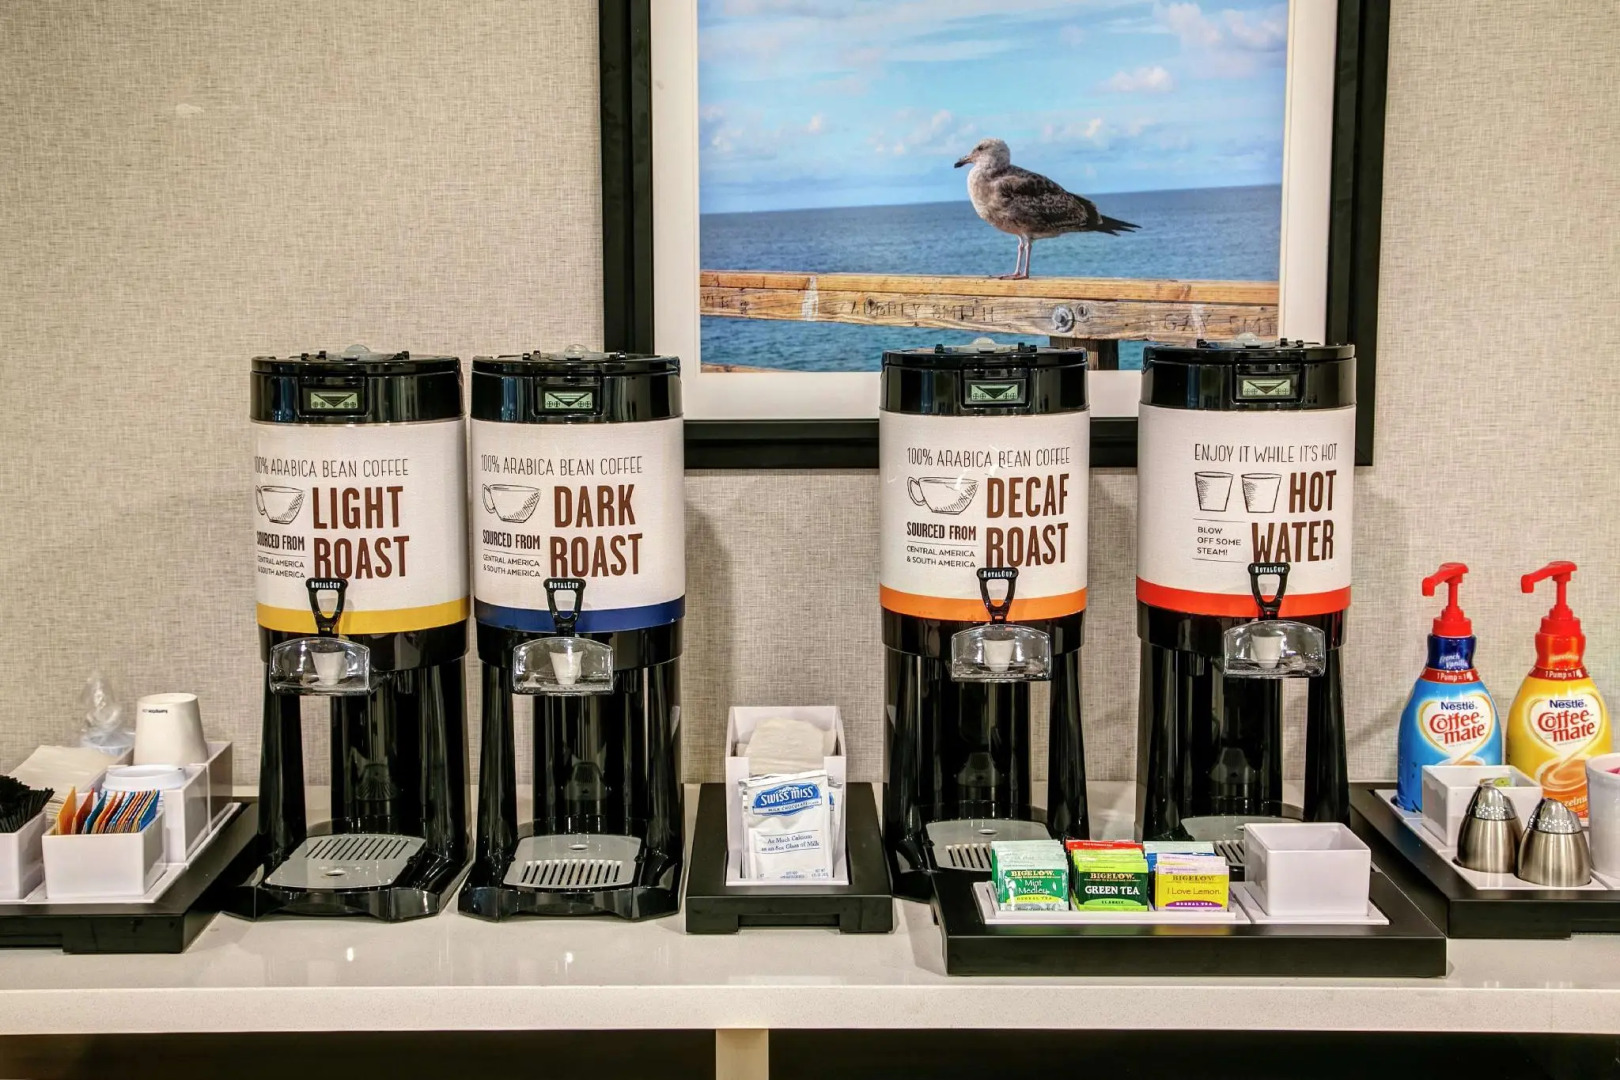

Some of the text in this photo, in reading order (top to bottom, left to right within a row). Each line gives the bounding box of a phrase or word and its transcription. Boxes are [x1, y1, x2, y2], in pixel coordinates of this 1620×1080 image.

[906, 446, 1071, 469] 100% ARABICA BEAN COFFEE
[1194, 443, 1338, 462] ENJOY IT WHILE IT'S HOT
[270, 458, 318, 478] ARABICA
[322, 459, 357, 478] BEAN
[363, 458, 409, 478] COFFEE
[480, 454, 643, 476] 100% ARABICA BEAN COFFEE
[986, 473, 1070, 519] DECAF
[1289, 469, 1337, 513] HOT
[312, 485, 404, 530] LIGHT
[553, 484, 636, 528] DARK
[482, 529, 541, 550] SOURCED FROM
[906, 521, 977, 541] SOURCED FROM
[1197, 526, 1223, 535] BLOW
[256, 530, 305, 551] SOURCED FROM
[986, 522, 1069, 568] ROAST
[1197, 536, 1241, 546] OFF SOME
[1251, 519, 1335, 563] WATER
[313, 535, 410, 580] ROAST
[482, 553, 540, 567] CENTRAL AMERICA
[550, 533, 643, 578] ROAST
[906, 545, 975, 558] CENTRAL AMERICA
[1197, 546, 1228, 556] STEAM!
[275, 559, 305, 569] AMERICA
[906, 555, 976, 568] & SOUTH AMERICA
[275, 568, 305, 579] AMERICA
[487, 565, 506, 574] SOUTH
[506, 568, 541, 578] AMERICA
[1440, 673, 1457, 682] Pump
[1549, 671, 1567, 680] Pump
[1444, 723, 1485, 744] mate
[1552, 722, 1595, 742] mate
[1010, 870, 1054, 878] BIGELOW
[1024, 879, 1043, 887] Mint
[1090, 872, 1135, 880] BIGELOW
[1084, 885, 1141, 896] GREEN TEA
[1171, 887, 1192, 895] Love
